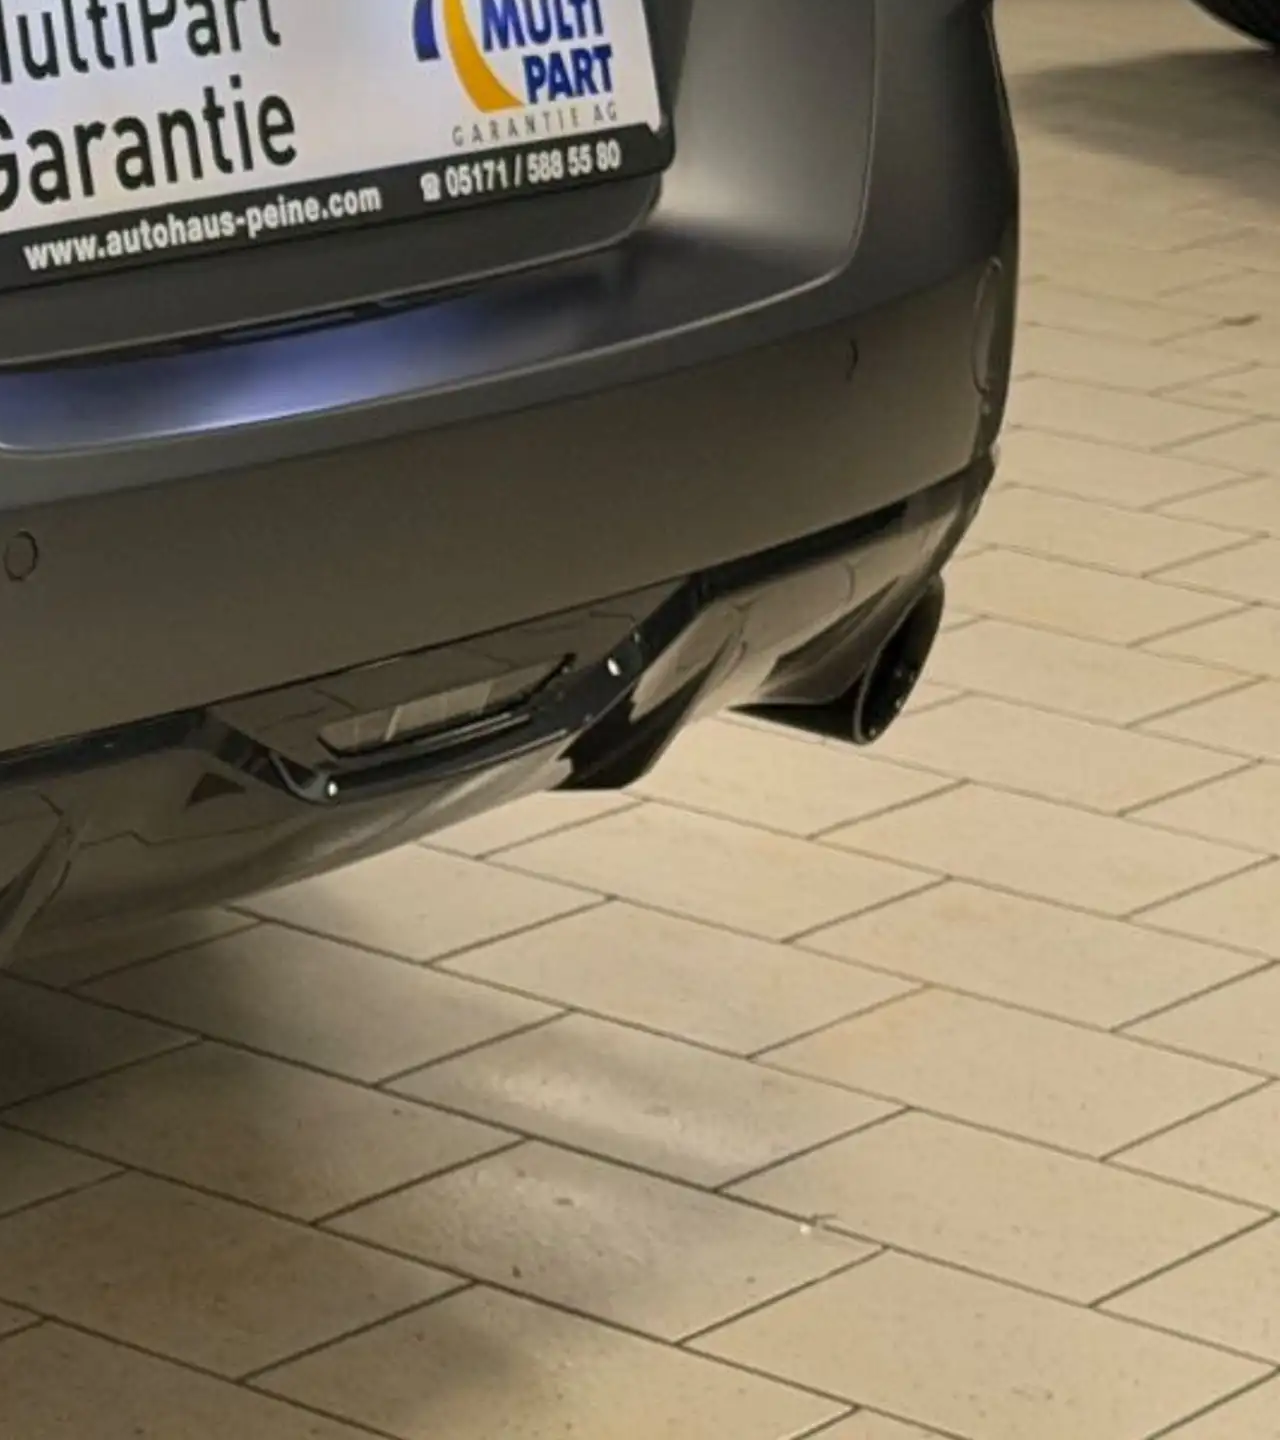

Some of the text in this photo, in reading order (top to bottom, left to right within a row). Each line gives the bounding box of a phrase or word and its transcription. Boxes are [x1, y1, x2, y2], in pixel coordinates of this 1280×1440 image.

[522, 43, 613, 104] PART
[451, 100, 619, 148] GARANTIE AG
[445, 157, 509, 197] 05171
[567, 143, 593, 176] 55
[595, 138, 622, 171] 80
[23, 186, 383, 271] www.autohaus-peine.com
